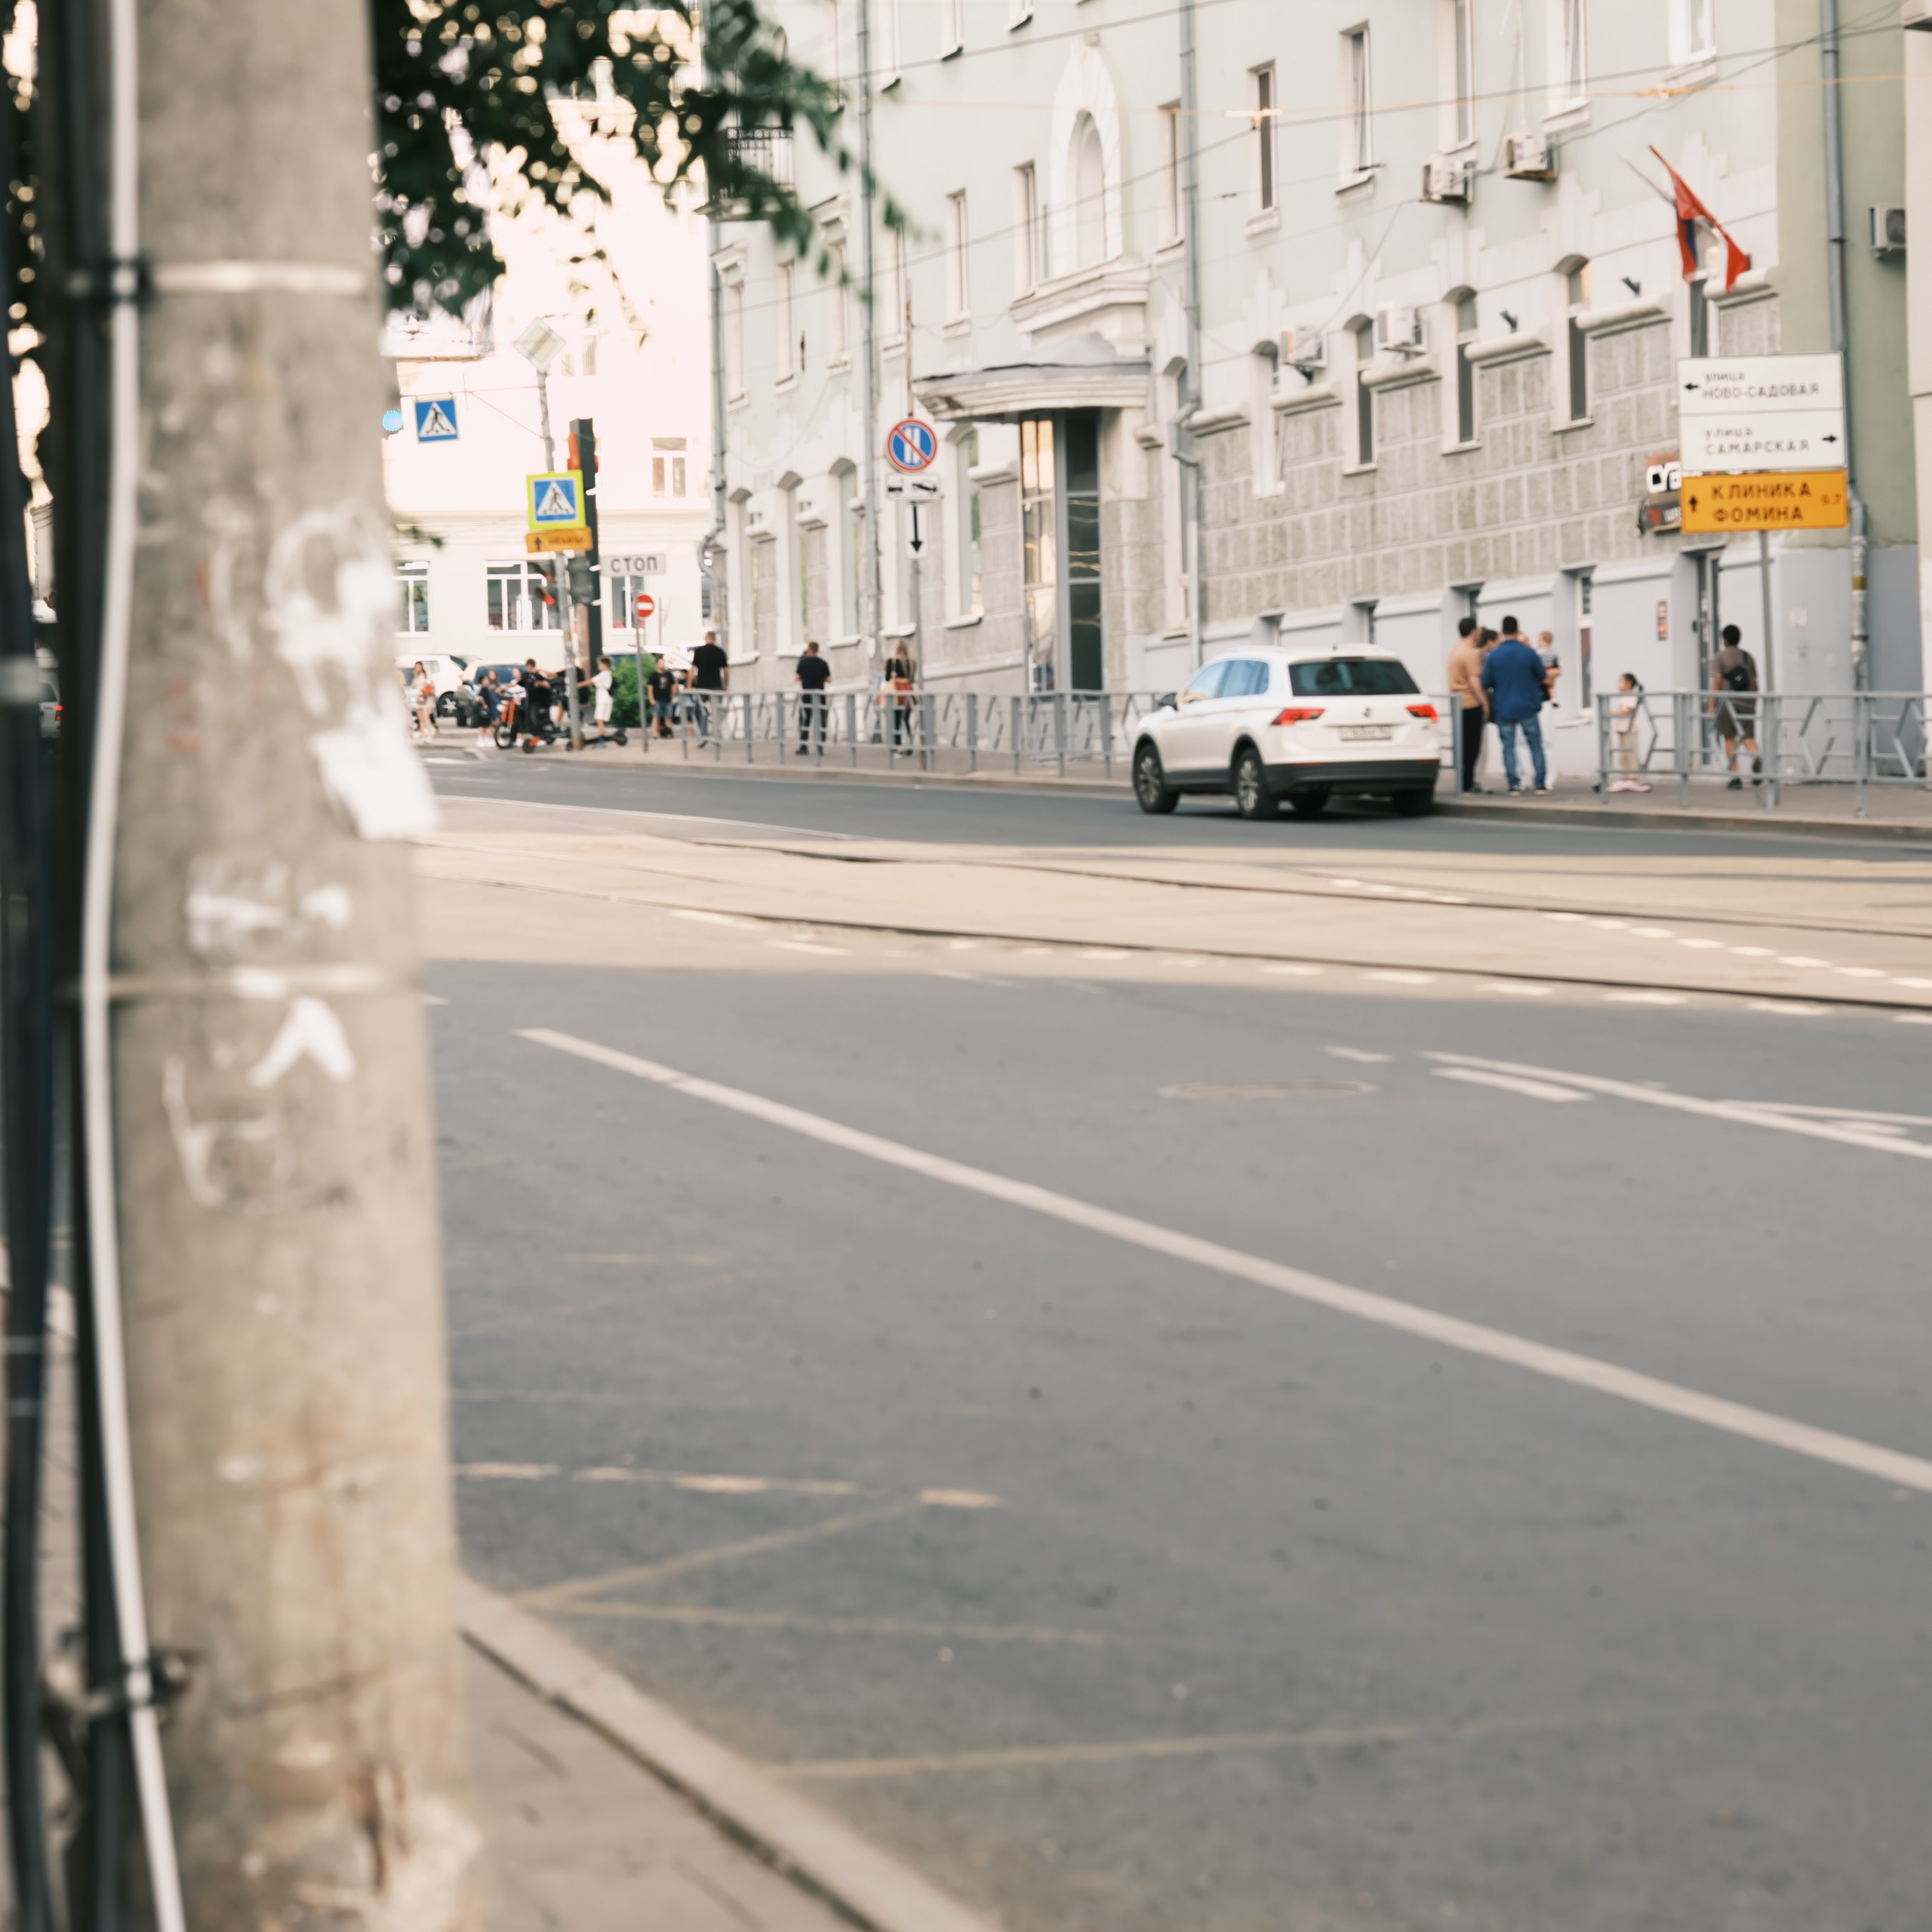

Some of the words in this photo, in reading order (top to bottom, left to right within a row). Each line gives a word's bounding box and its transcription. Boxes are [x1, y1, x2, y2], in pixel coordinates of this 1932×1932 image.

[1703, 383, 1819, 399] НОВО-САДОВАЯ
[1704, 439, 1809, 456] САМАРСКАЯ
[1712, 482, 1811, 500] КЛИНИКА
[1712, 506, 1803, 522] ФОМИНА
